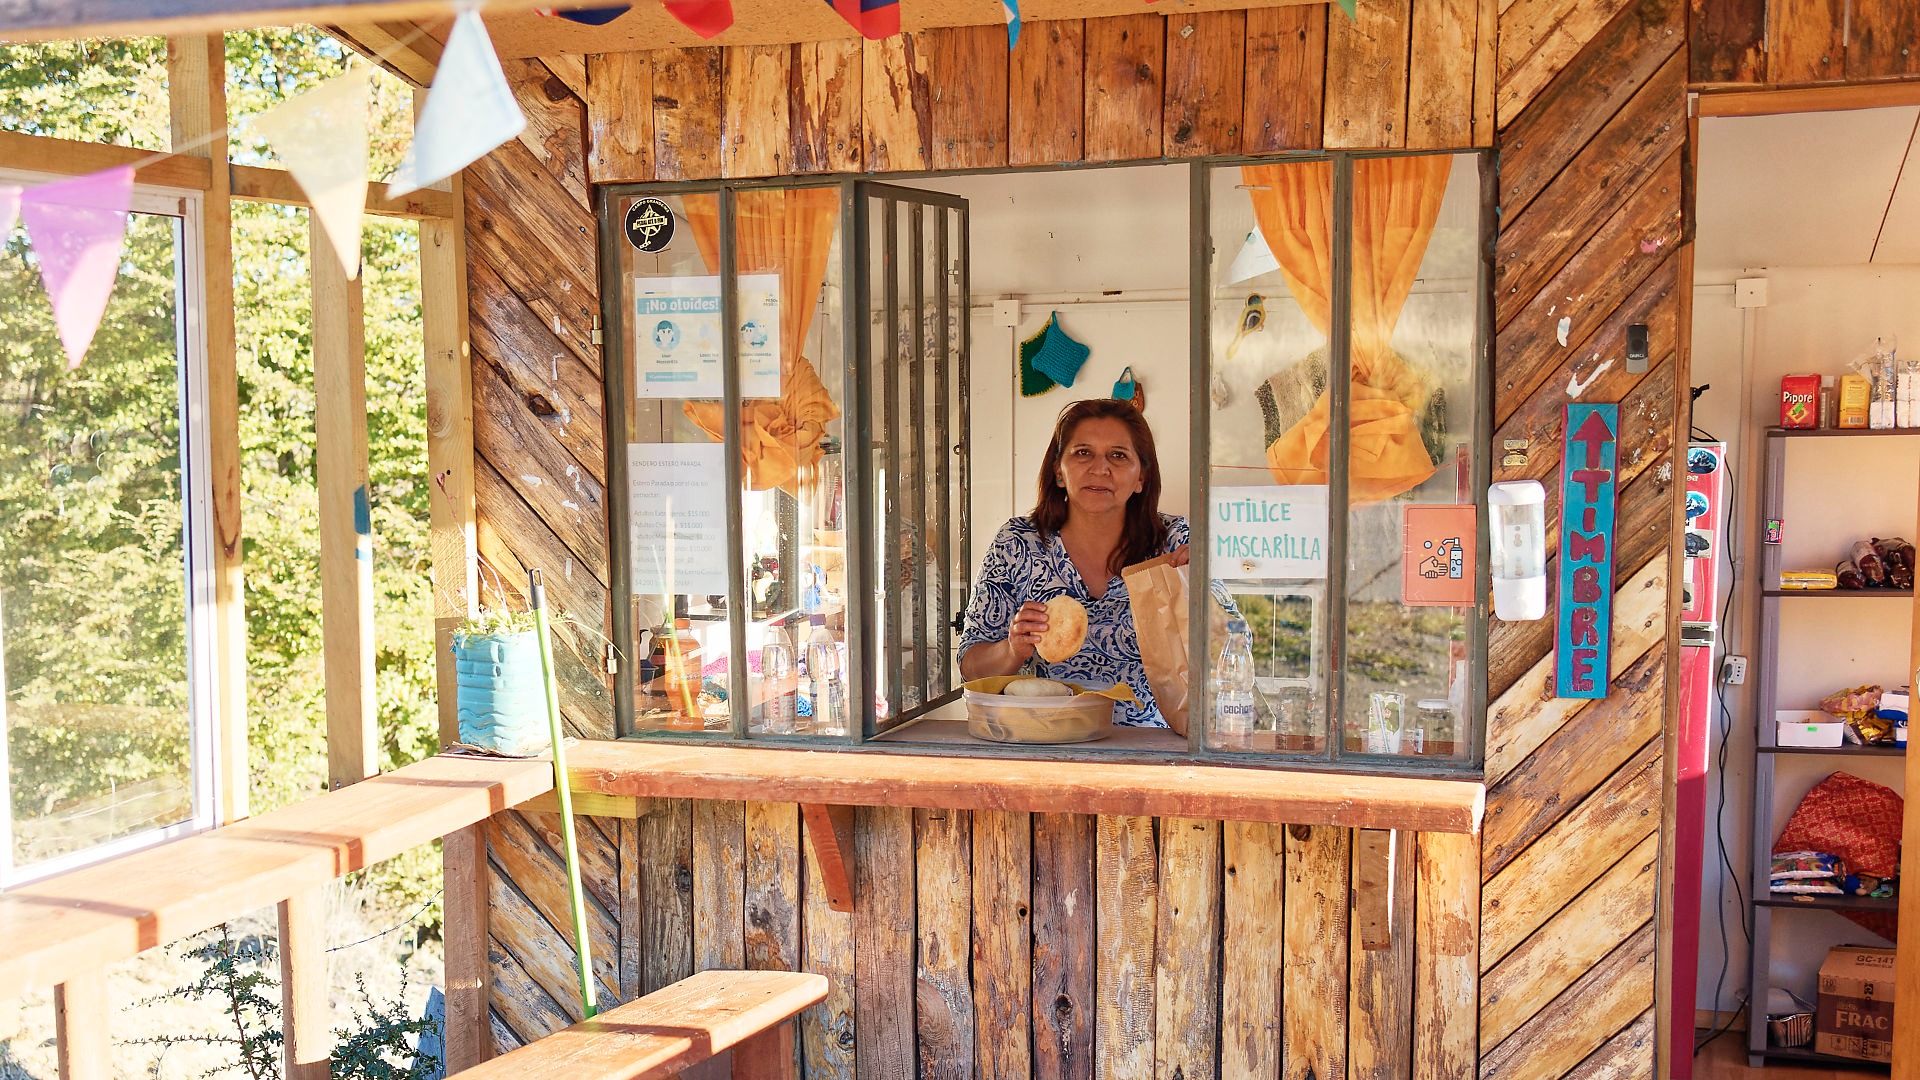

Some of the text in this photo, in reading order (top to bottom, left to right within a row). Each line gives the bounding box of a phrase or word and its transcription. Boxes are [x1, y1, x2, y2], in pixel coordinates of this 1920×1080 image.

[646, 297, 719, 314] ¡No olvides!
[1219, 498, 1291, 523] UTILICE
[1217, 534, 1321, 561] MASCARILLA
[1570, 469, 1612, 693] TIMBRE
[1835, 1010, 1888, 1031] FRAC
